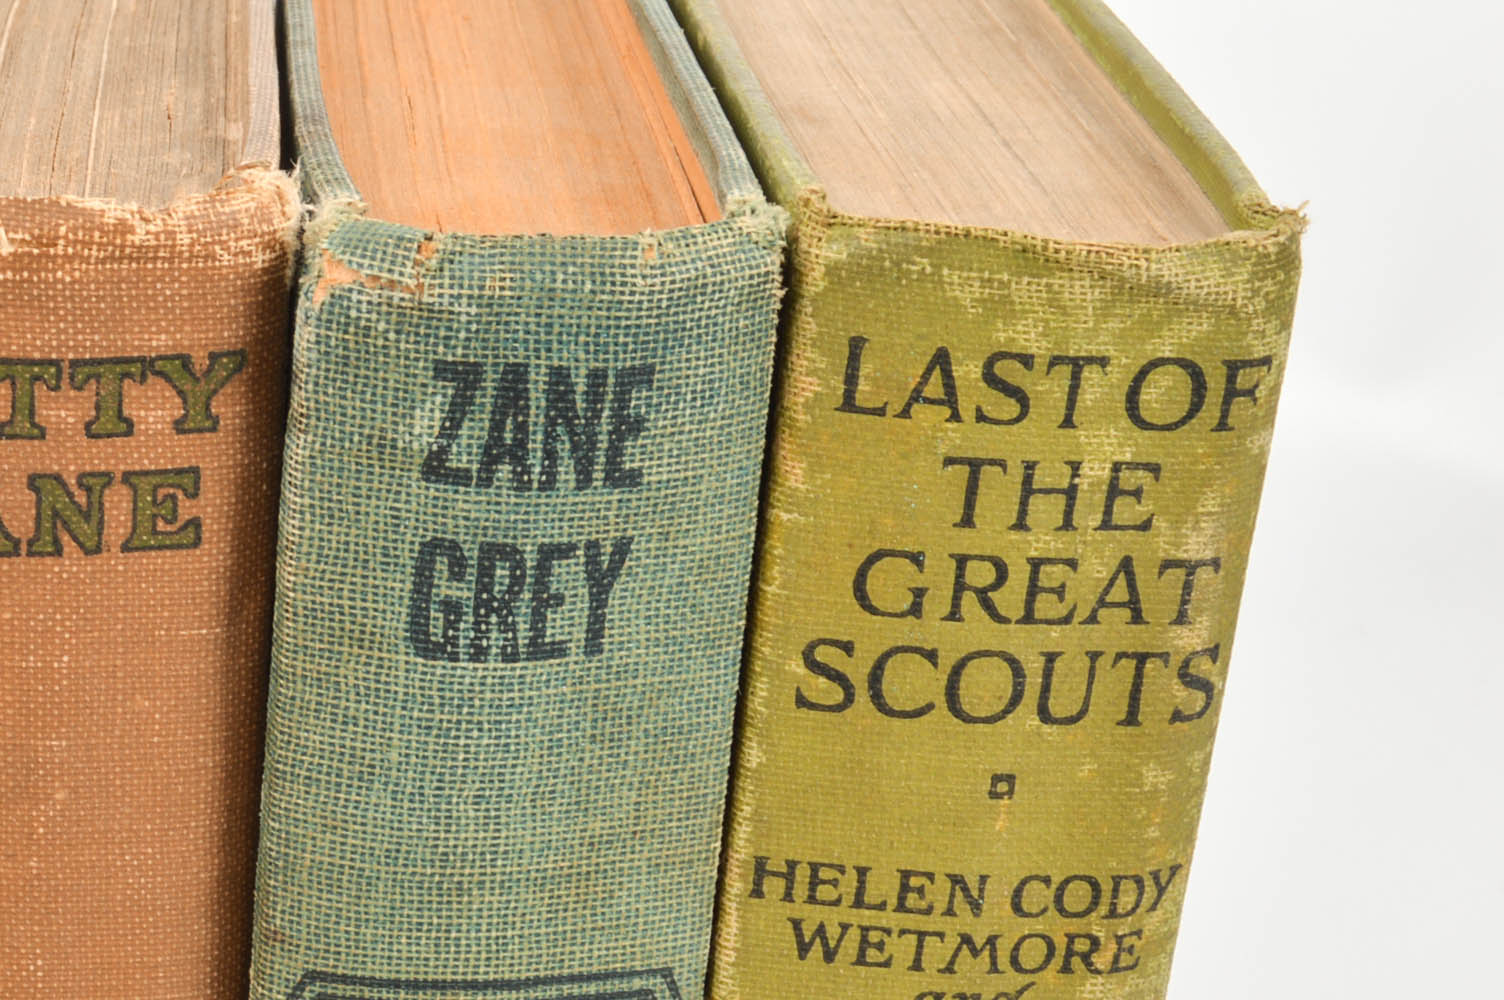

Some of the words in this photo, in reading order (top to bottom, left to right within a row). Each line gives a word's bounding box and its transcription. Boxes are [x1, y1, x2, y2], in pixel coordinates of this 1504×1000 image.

[421, 359, 657, 492] ZANE
[834, 336, 1110, 429] LAST
[1124, 355, 1274, 433] OF
[942, 455, 1162, 532] THE
[410, 536, 635, 663] GREY
[852, 547, 1222, 627] GREAT
[795, 637, 1221, 728] SCOUTS
[747, 855, 990, 919] HELEN
[1010, 863, 1183, 920] CODY
[787, 917, 1144, 976] WETMORE
